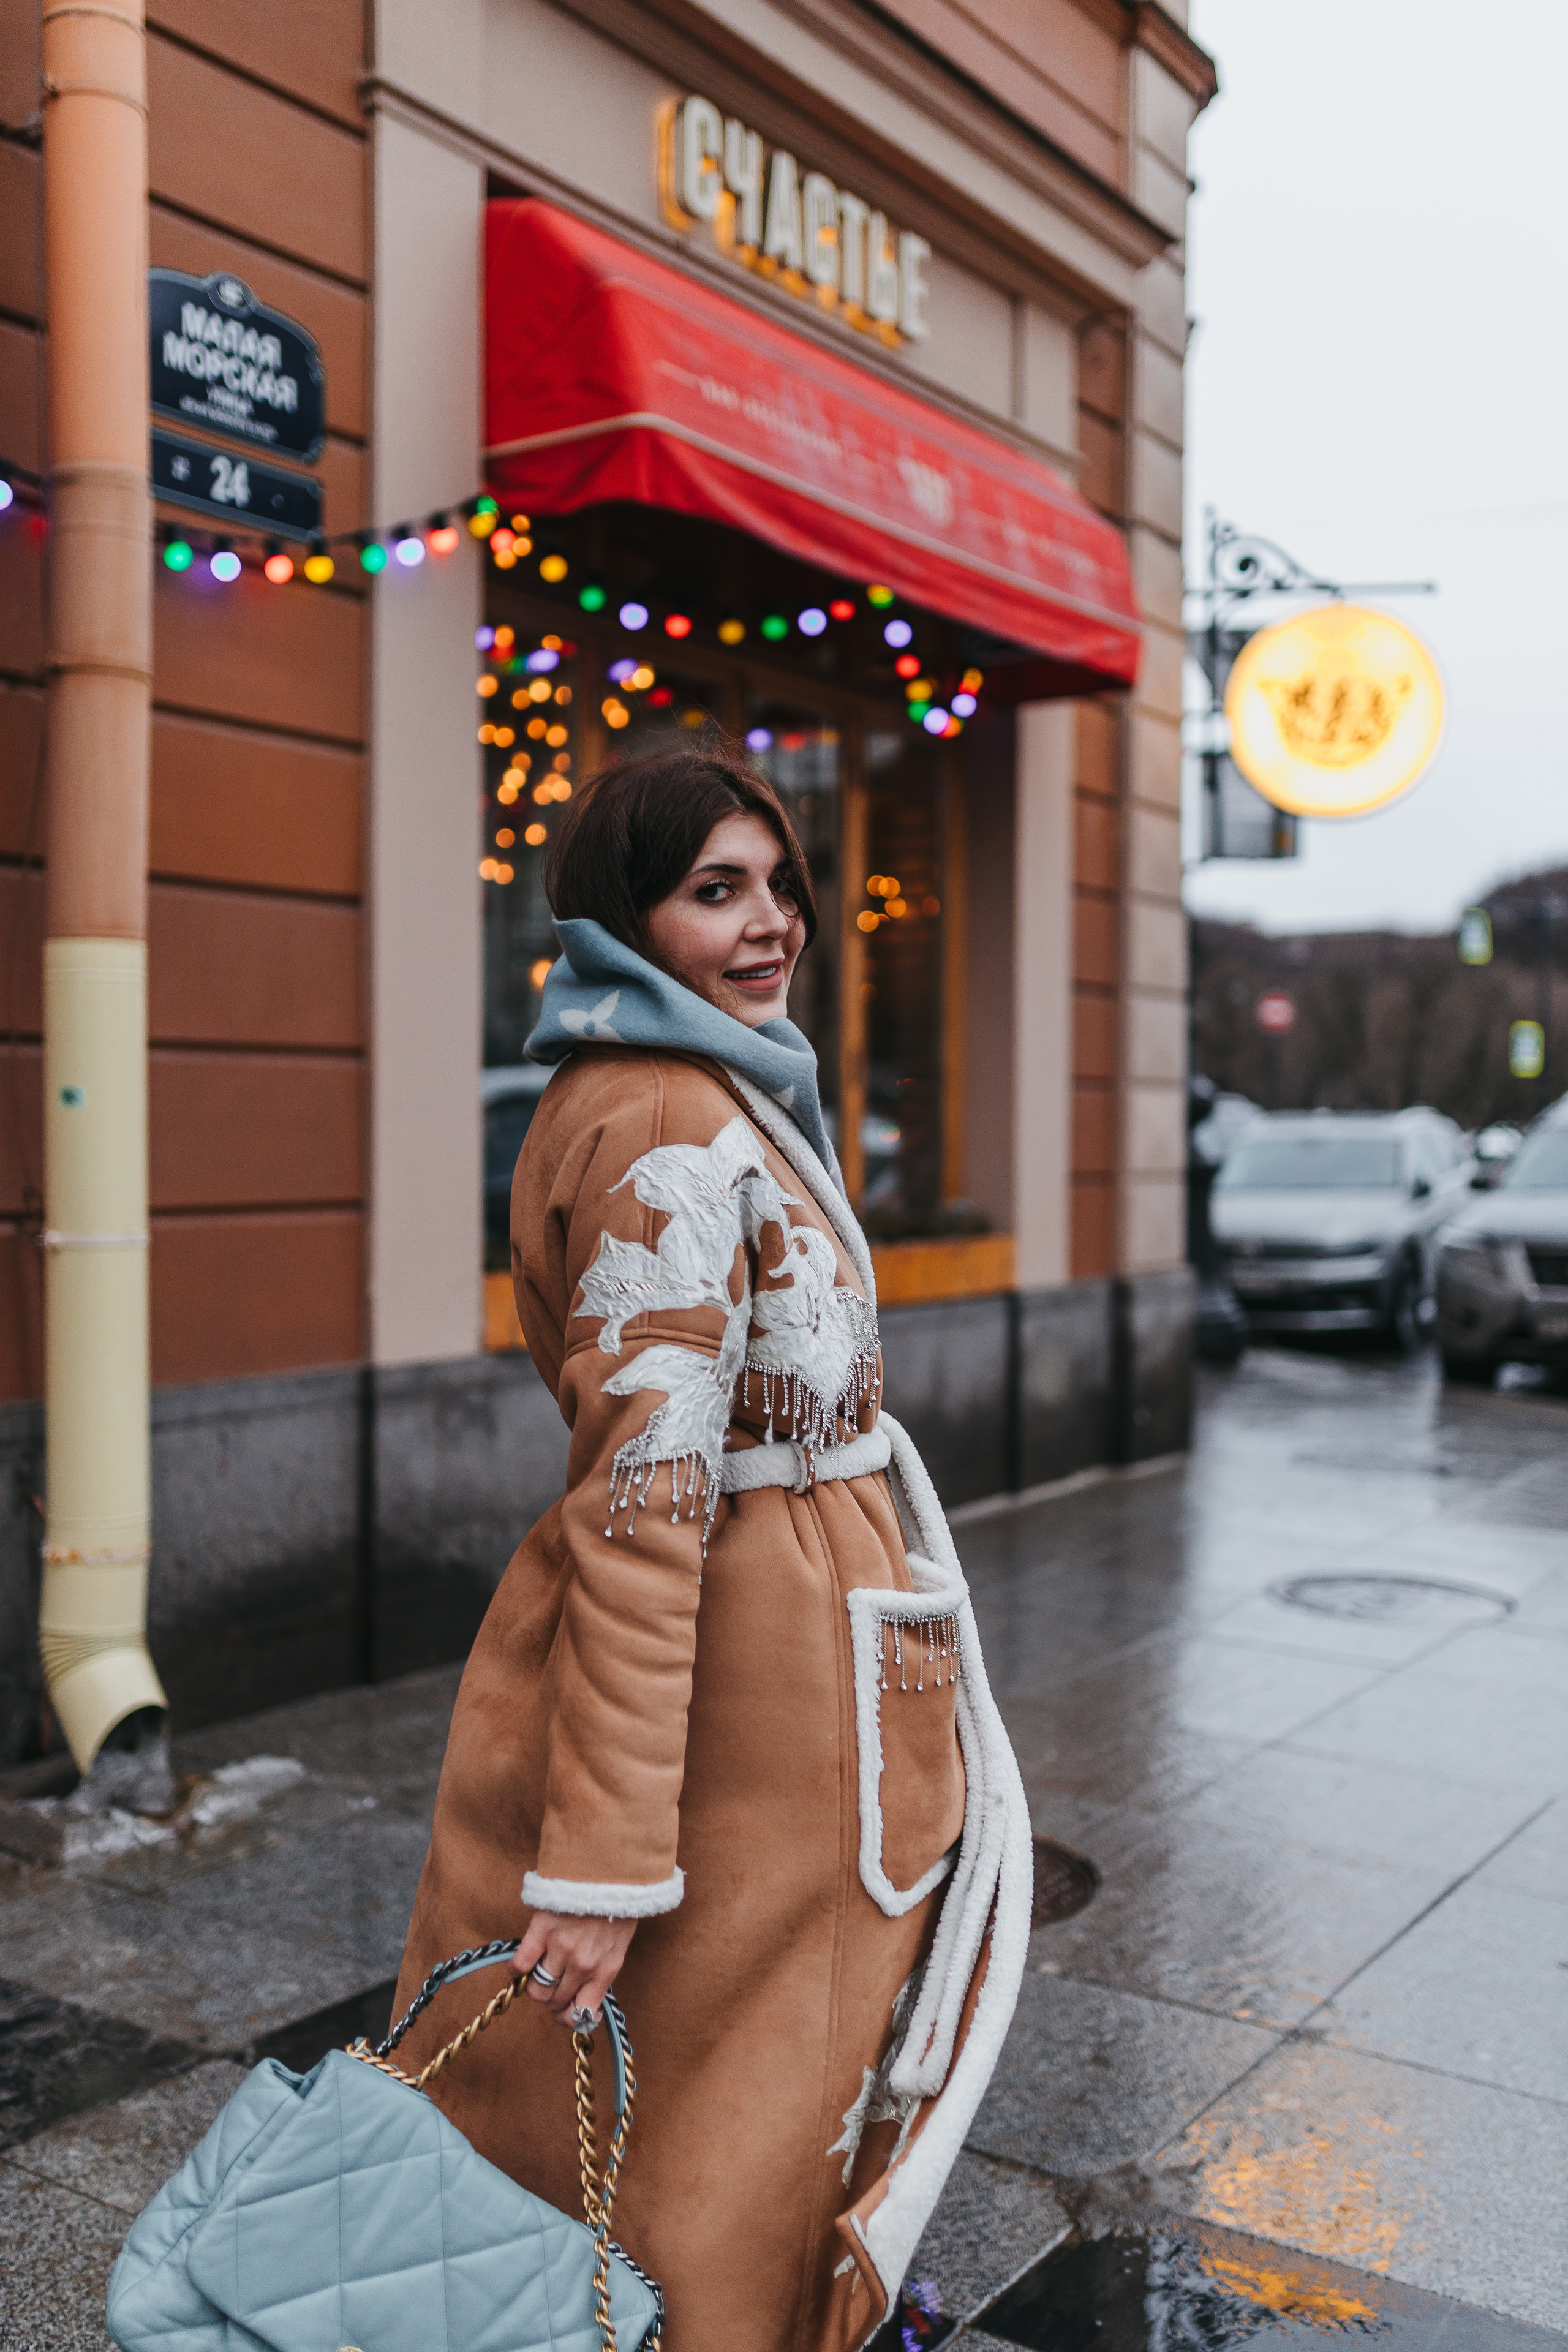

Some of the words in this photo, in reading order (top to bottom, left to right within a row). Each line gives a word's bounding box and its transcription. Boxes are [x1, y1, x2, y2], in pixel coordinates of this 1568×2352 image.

[681, 94, 933, 339] СЧАСТЬЕ
[163, 330, 299, 414] МОРСКАЯ
[181, 301, 282, 371] МАЛАЯ
[209, 455, 251, 508] 24
